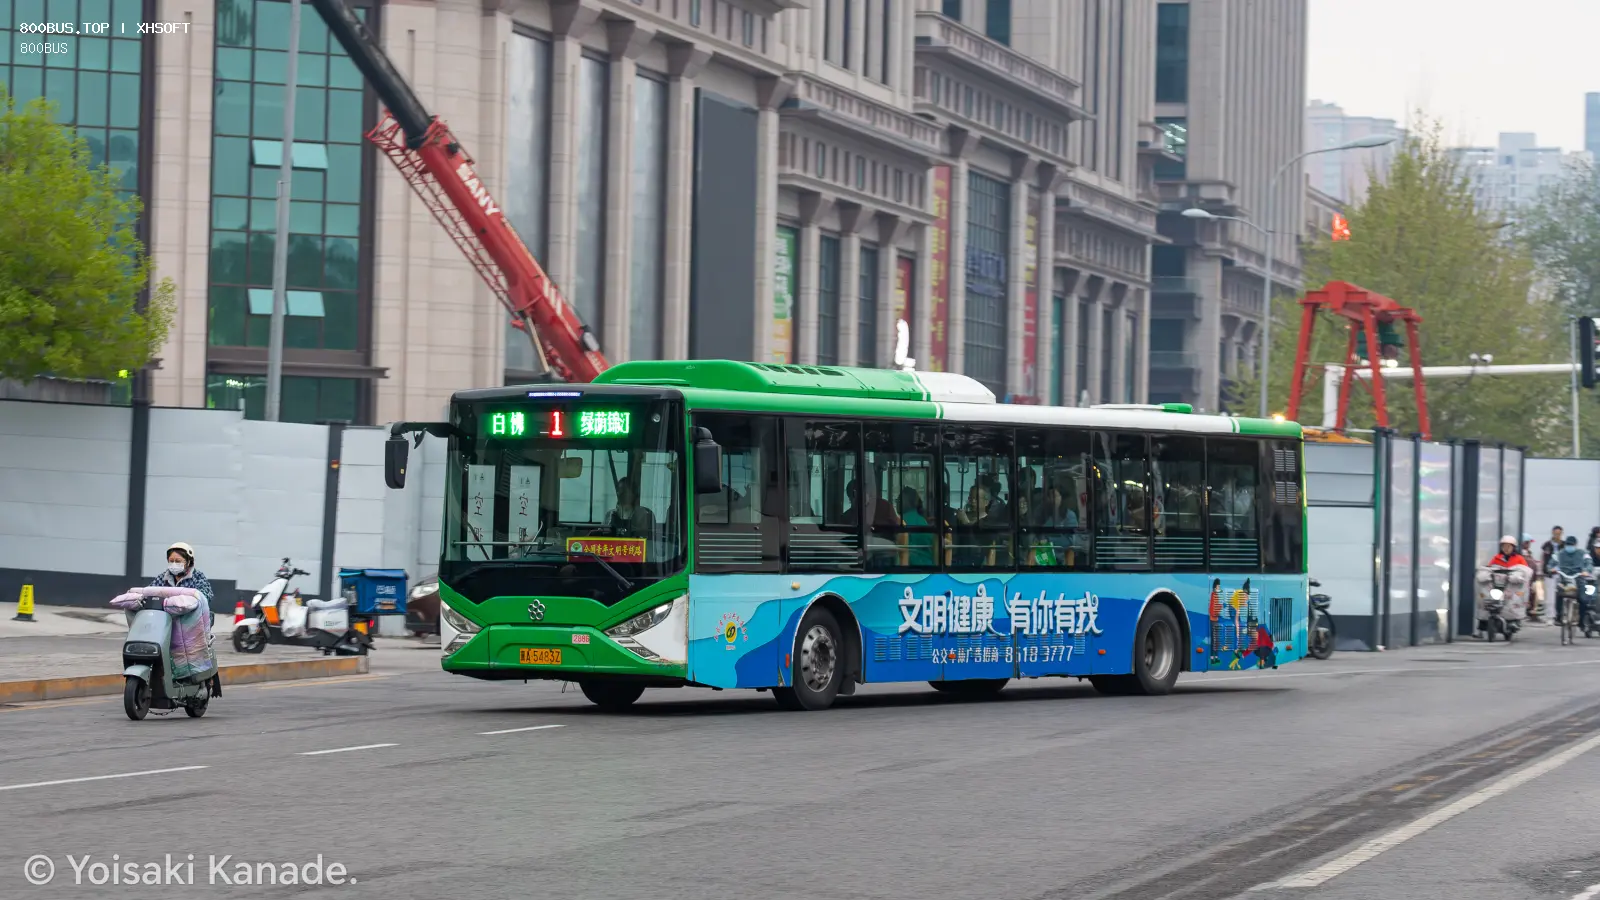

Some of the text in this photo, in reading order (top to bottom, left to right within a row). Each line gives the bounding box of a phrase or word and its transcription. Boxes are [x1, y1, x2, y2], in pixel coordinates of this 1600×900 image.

[551, 411, 563, 436] 1
[898, 583, 1103, 636] 文明健康 有你有我
[1042, 645, 1074, 663] 3777
